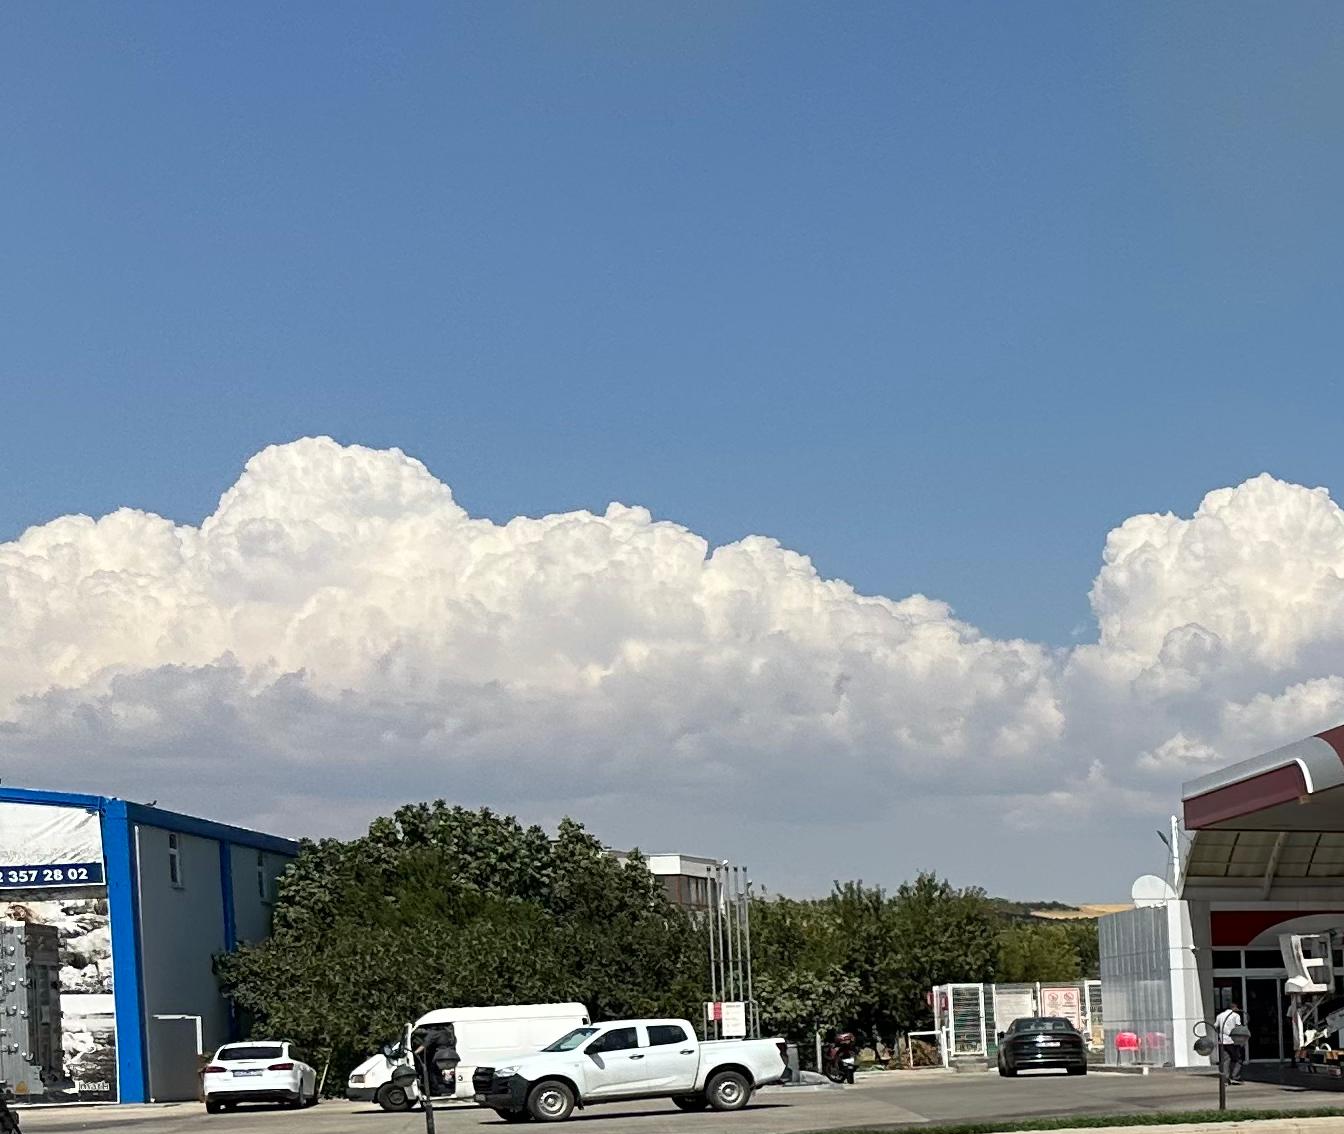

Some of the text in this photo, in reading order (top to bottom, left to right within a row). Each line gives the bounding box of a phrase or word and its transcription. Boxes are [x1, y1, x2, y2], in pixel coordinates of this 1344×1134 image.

[8, 870, 38, 883] 357
[43, 869, 63, 881] 28
[67, 868, 88, 880] 02
